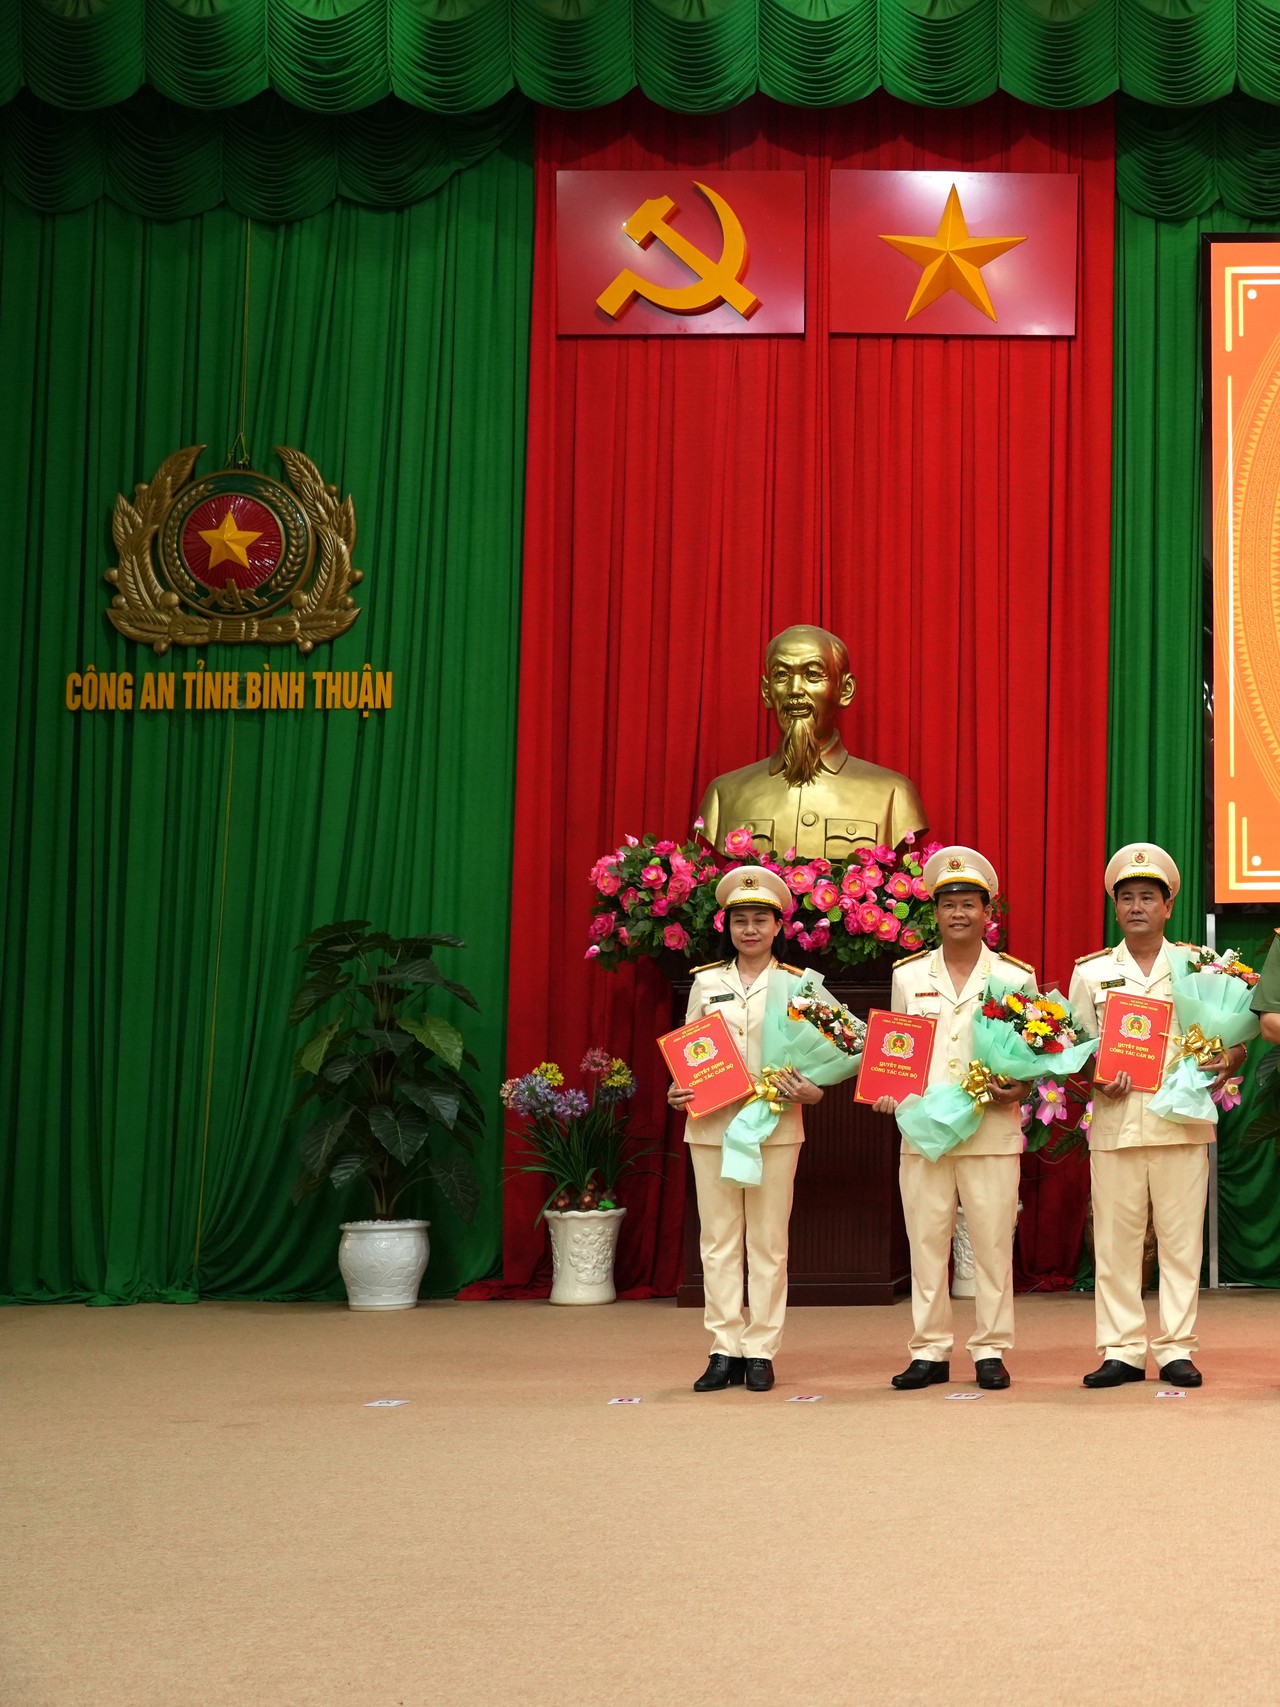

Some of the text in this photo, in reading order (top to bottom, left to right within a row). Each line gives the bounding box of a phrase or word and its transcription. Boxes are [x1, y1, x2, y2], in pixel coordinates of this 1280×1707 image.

[65, 659, 393, 718] CÔNG AN TỈNH BÌNH THUẬN
